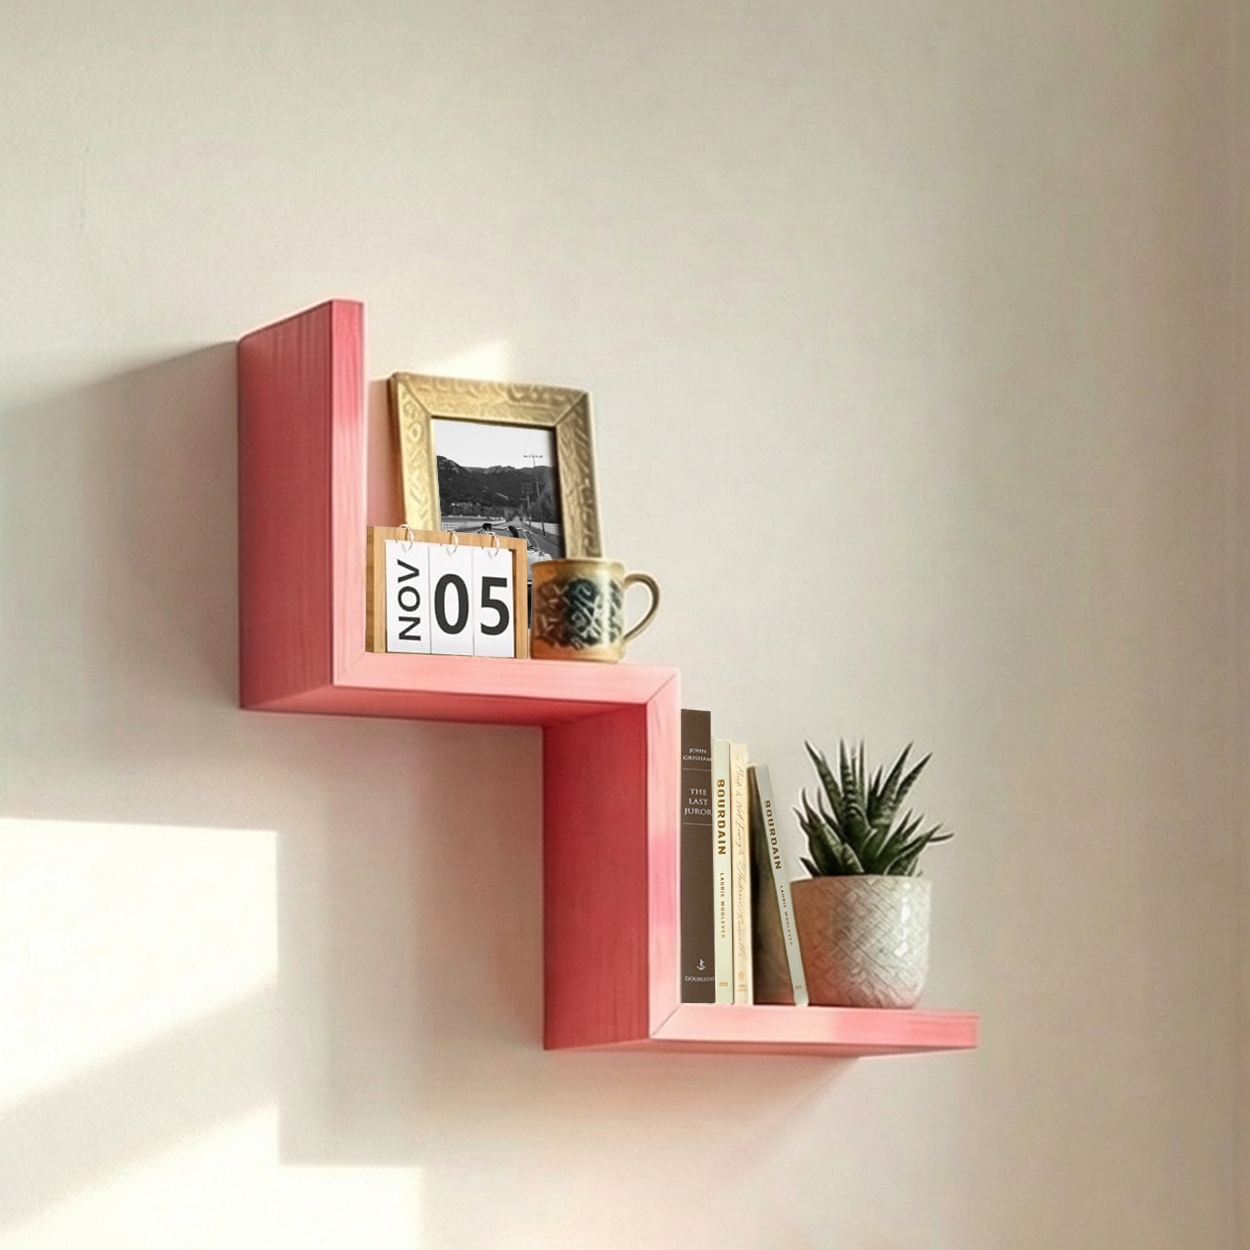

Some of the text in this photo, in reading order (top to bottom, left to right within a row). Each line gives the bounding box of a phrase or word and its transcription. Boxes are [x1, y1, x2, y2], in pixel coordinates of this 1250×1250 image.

[396, 558, 510, 641] NOV 05
[688, 797, 709, 806] LAST
[689, 788, 708, 796] THE
[716, 779, 727, 856] BOURDAIN
[764, 799, 782, 870] BOURDAIN
[779, 885, 794, 946] LAURIE WOOLEVER
